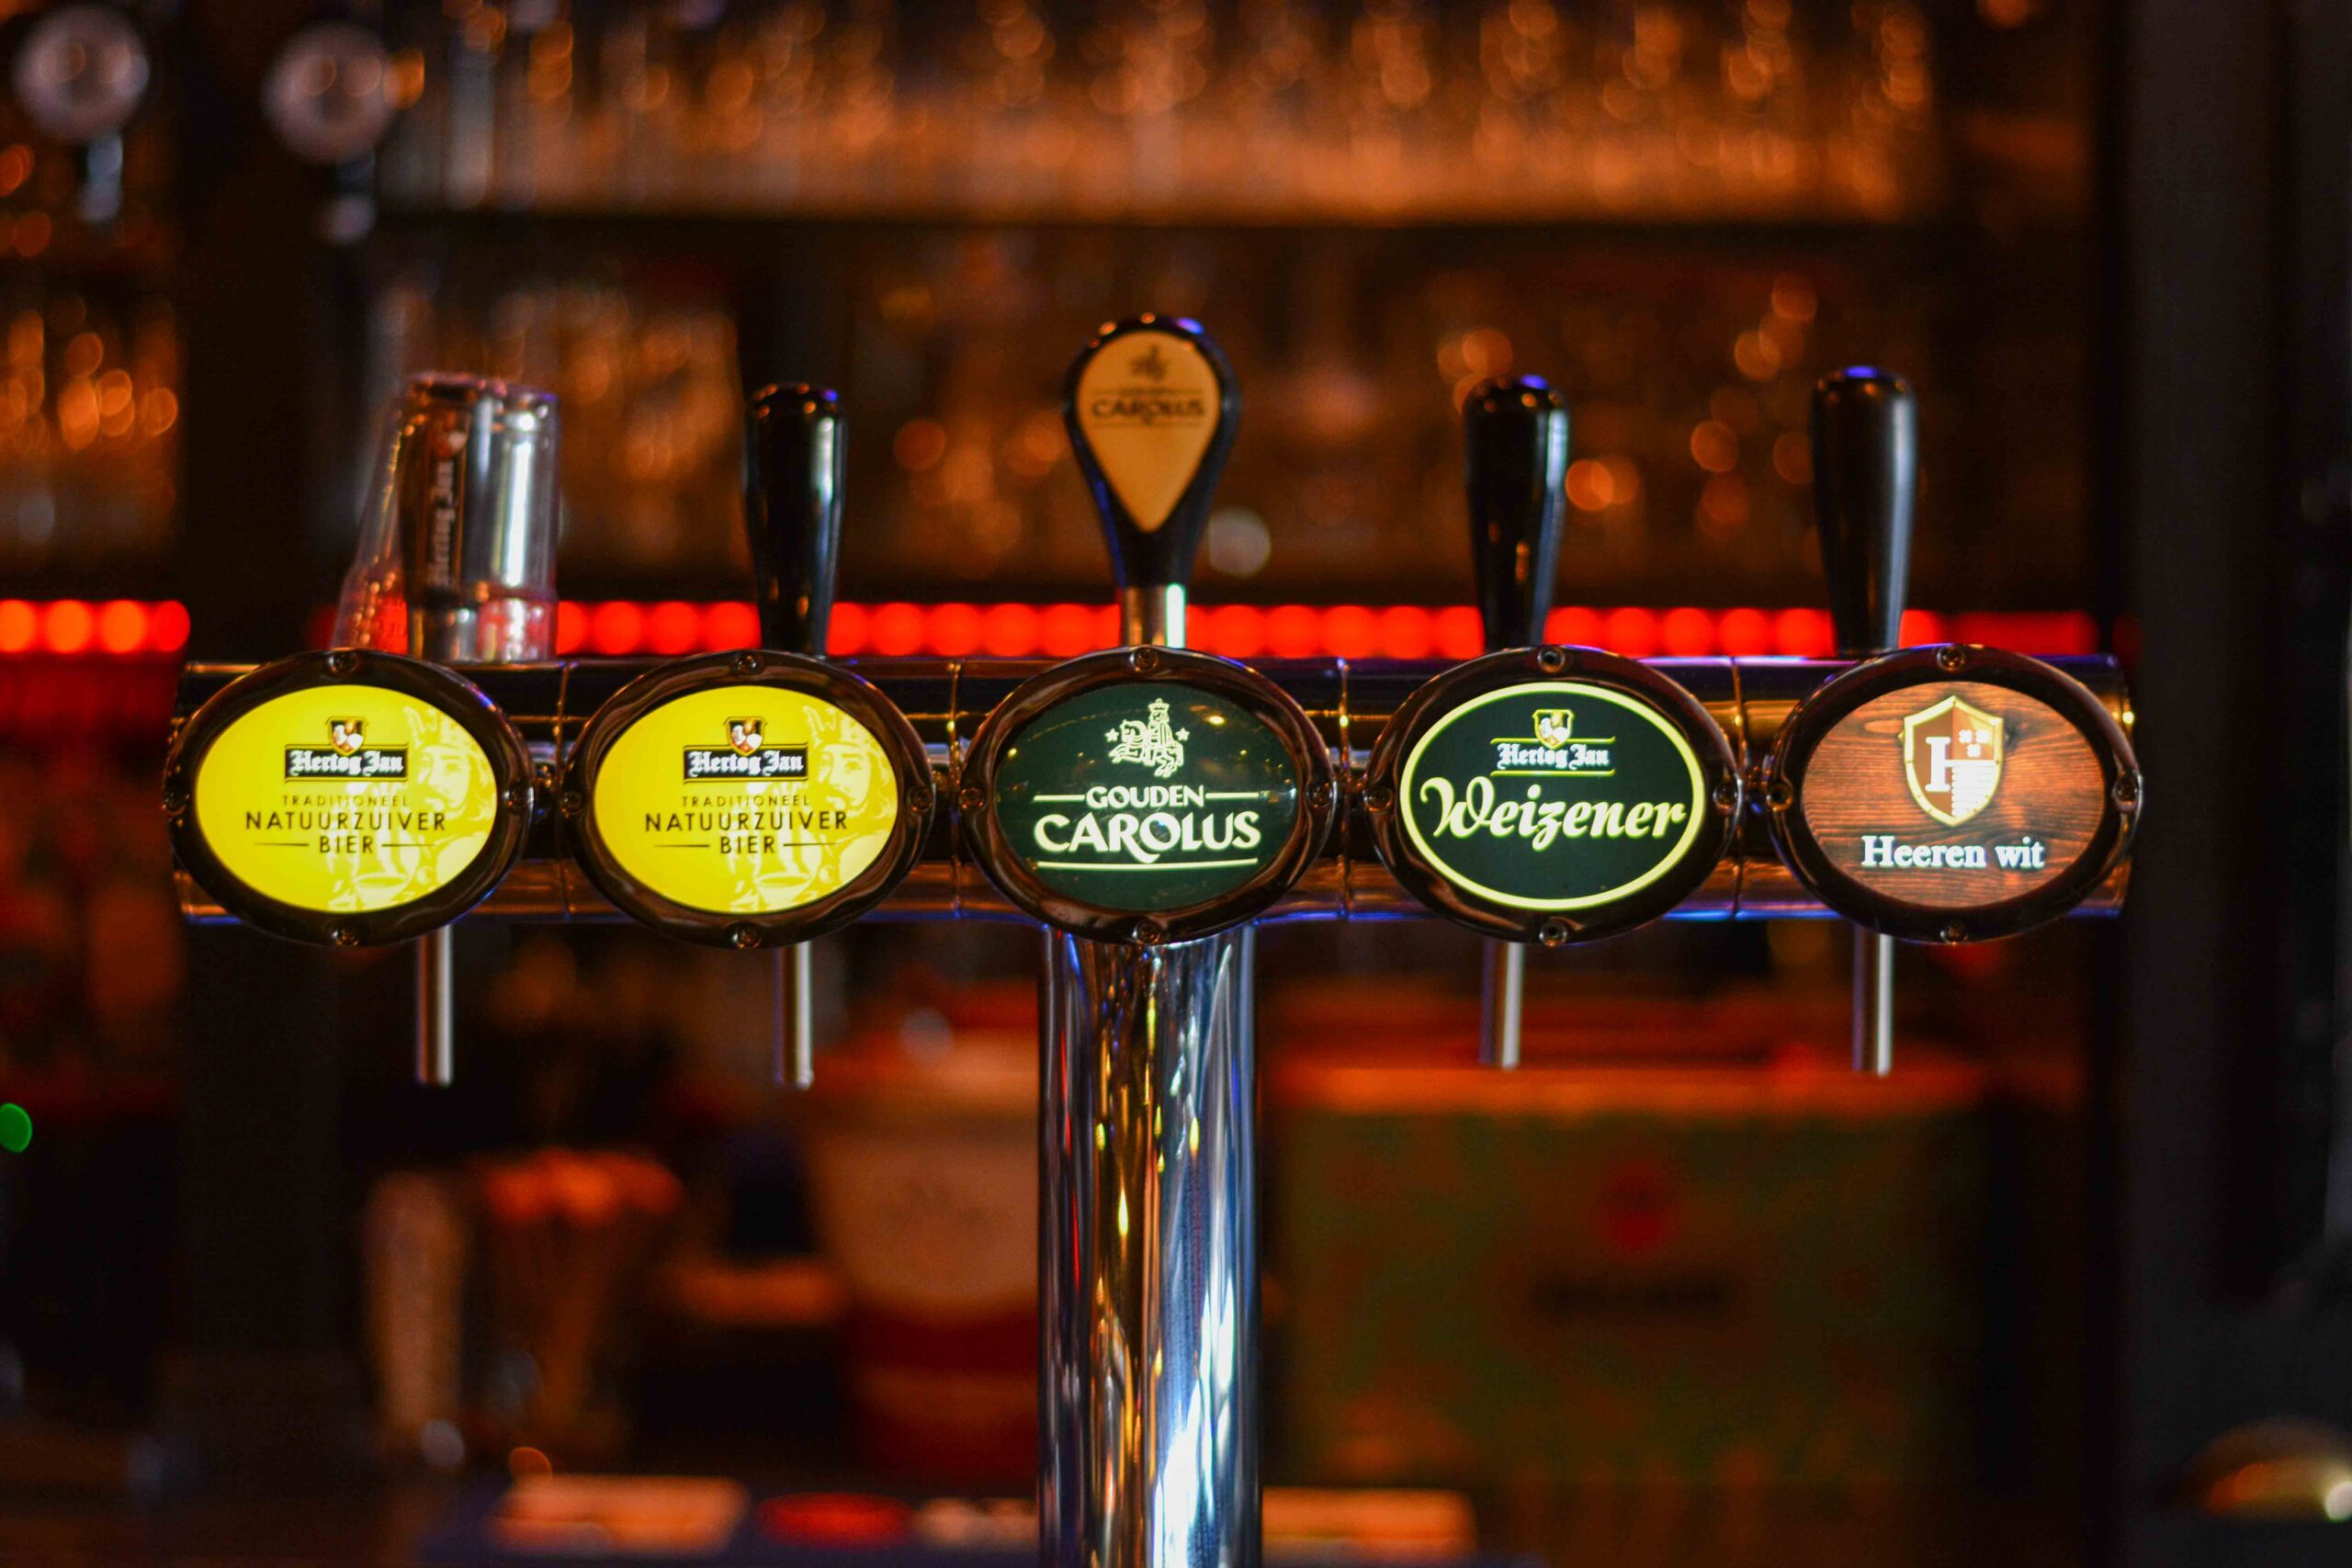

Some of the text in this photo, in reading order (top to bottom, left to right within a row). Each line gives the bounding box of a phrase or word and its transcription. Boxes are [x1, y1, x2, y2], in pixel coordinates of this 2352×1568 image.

[288, 750, 404, 776] Hertog Jan
[688, 750, 804, 776] Hertog Jan
[1497, 742, 1611, 770] Hertog Jan
[282, 795, 410, 807] TRADITIONEEL
[682, 794, 810, 807] TRADITIONEEL
[1086, 784, 1204, 808] GOUDEN
[245, 811, 446, 831] NATUURZUIVER
[645, 810, 848, 832] NATUURZUIVER
[1420, 776, 1687, 851] Weizener
[319, 835, 374, 853] BIER
[719, 835, 775, 854] BIER
[1034, 811, 1261, 863] CAROLUS
[1860, 835, 2045, 869] Heeren wit
